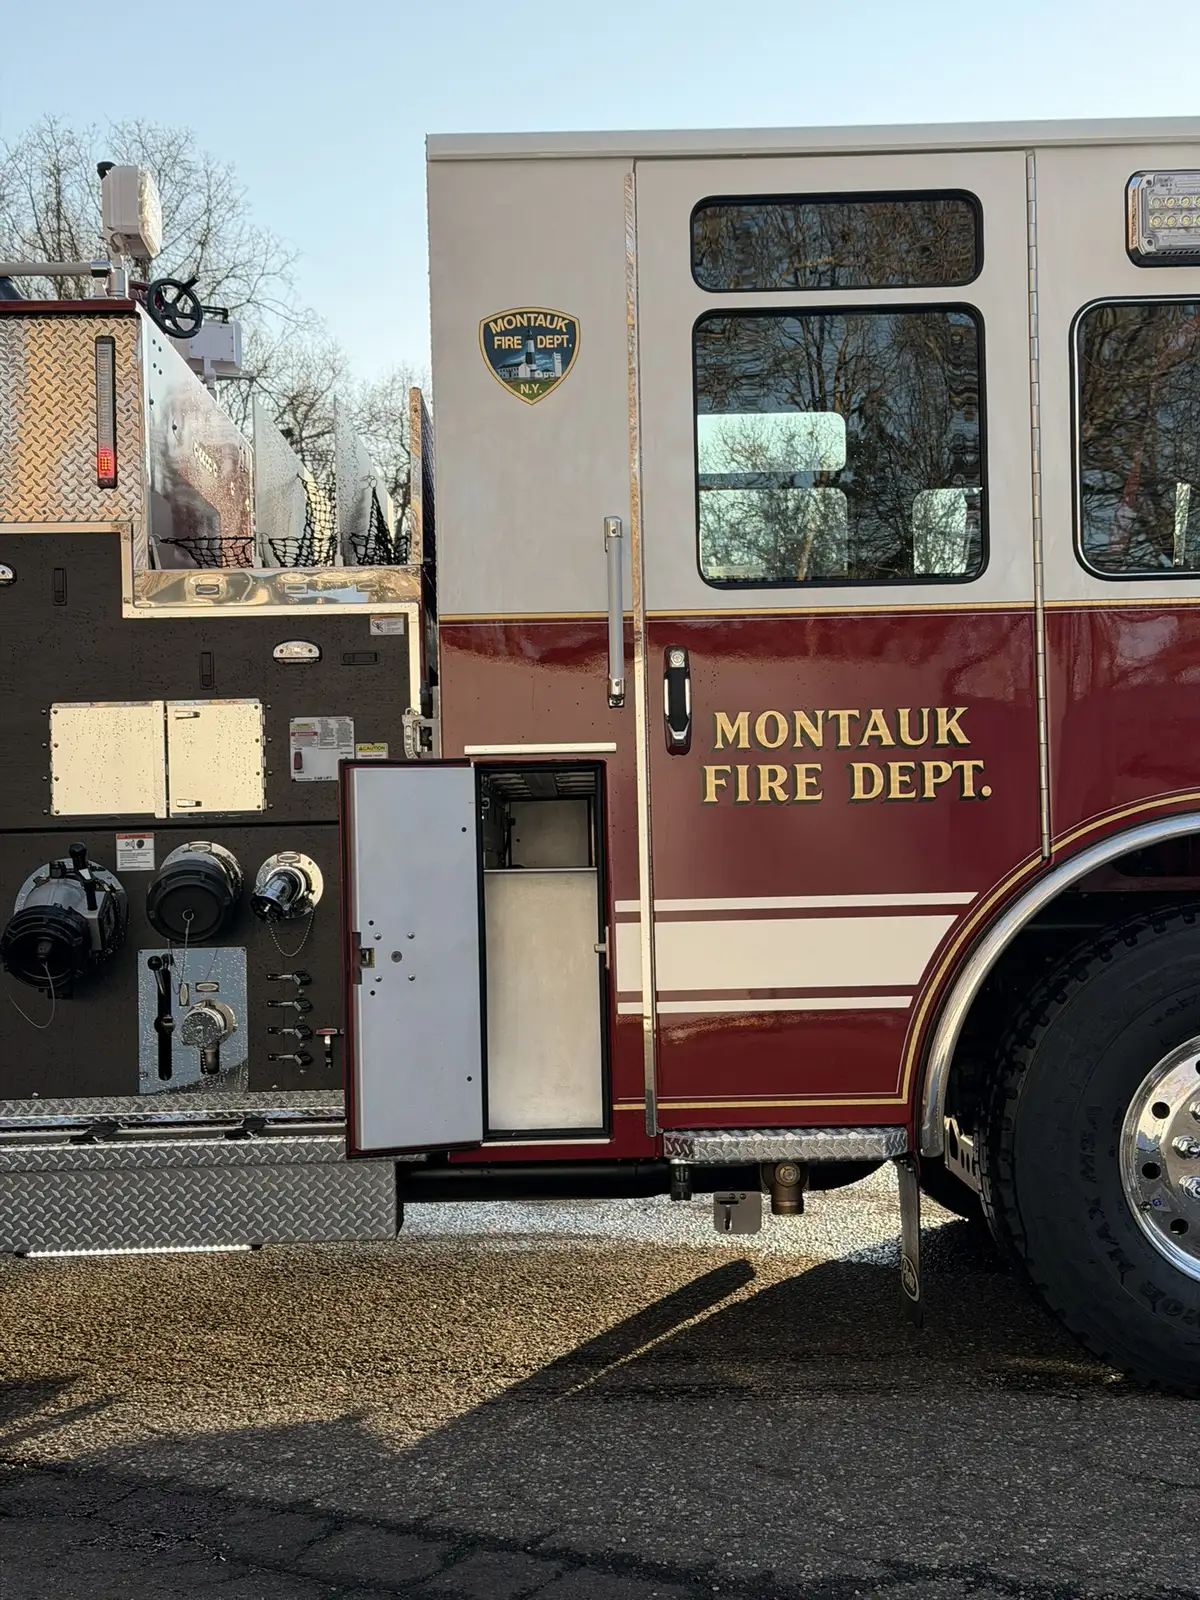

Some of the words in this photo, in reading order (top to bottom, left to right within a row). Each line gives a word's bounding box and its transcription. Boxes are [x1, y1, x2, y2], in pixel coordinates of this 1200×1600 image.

[489, 313, 570, 335] MONTAUK
[493, 336, 523, 349] FIRE
[536, 335, 573, 348] DEPT.
[520, 383, 543, 394] N.Y.
[713, 706, 971, 749] MONTAUK
[702, 763, 823, 803] FIRE
[849, 760, 993, 800] DEPT.
